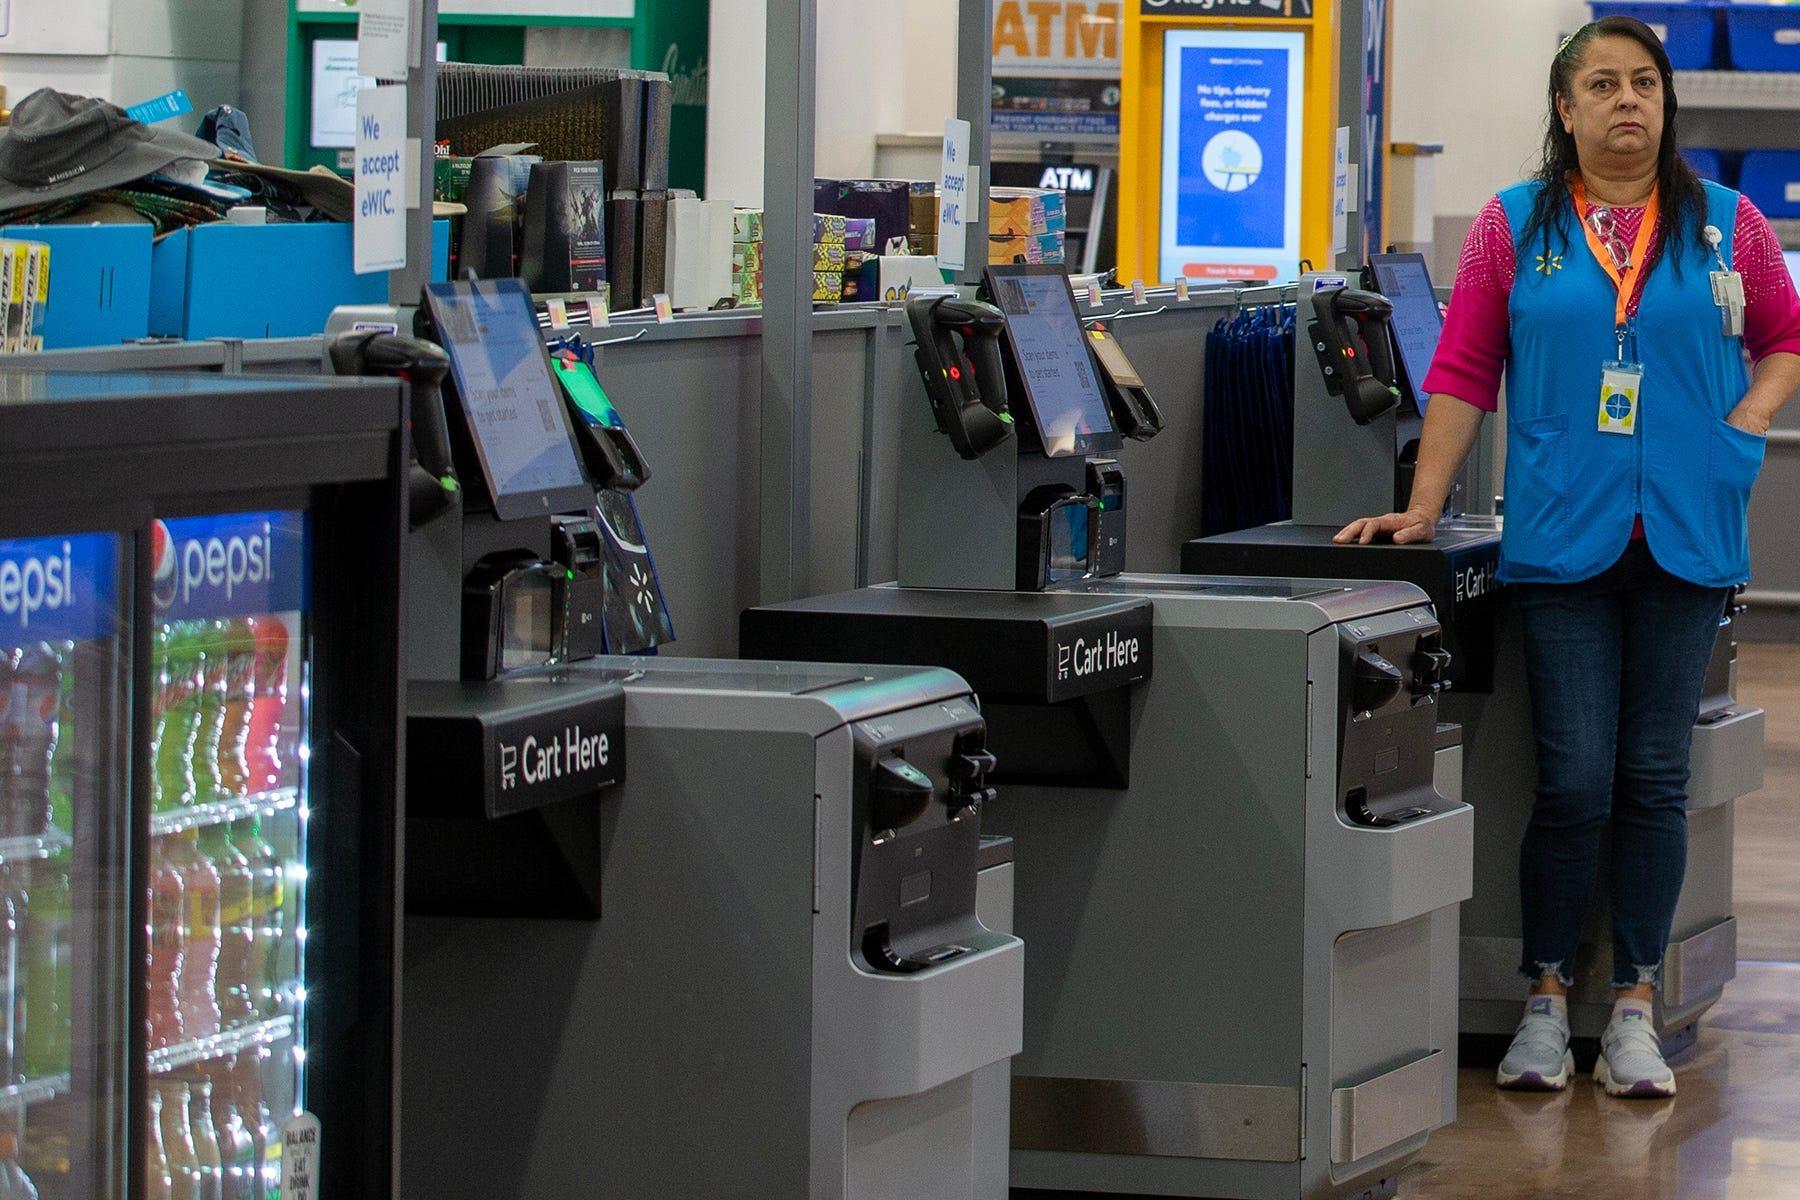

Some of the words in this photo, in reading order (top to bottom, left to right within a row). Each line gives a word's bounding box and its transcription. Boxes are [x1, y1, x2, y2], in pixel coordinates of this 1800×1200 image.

[992, 0, 1119, 60] ATM
[363, 114, 380, 141] We
[362, 149, 399, 180] accept
[946, 139, 956, 163] We
[944, 173, 965, 197] accept
[1040, 167, 1092, 190] ATM
[361, 190, 395, 218] eWIC.
[184, 520, 271, 604] pepsi
[0, 540, 72, 629] epsi
[1466, 566, 1485, 599] Cart
[1073, 637, 1103, 677] Cart
[1106, 630, 1139, 670] Here
[522, 732, 562, 784] Cart
[564, 726, 609, 774] Here
